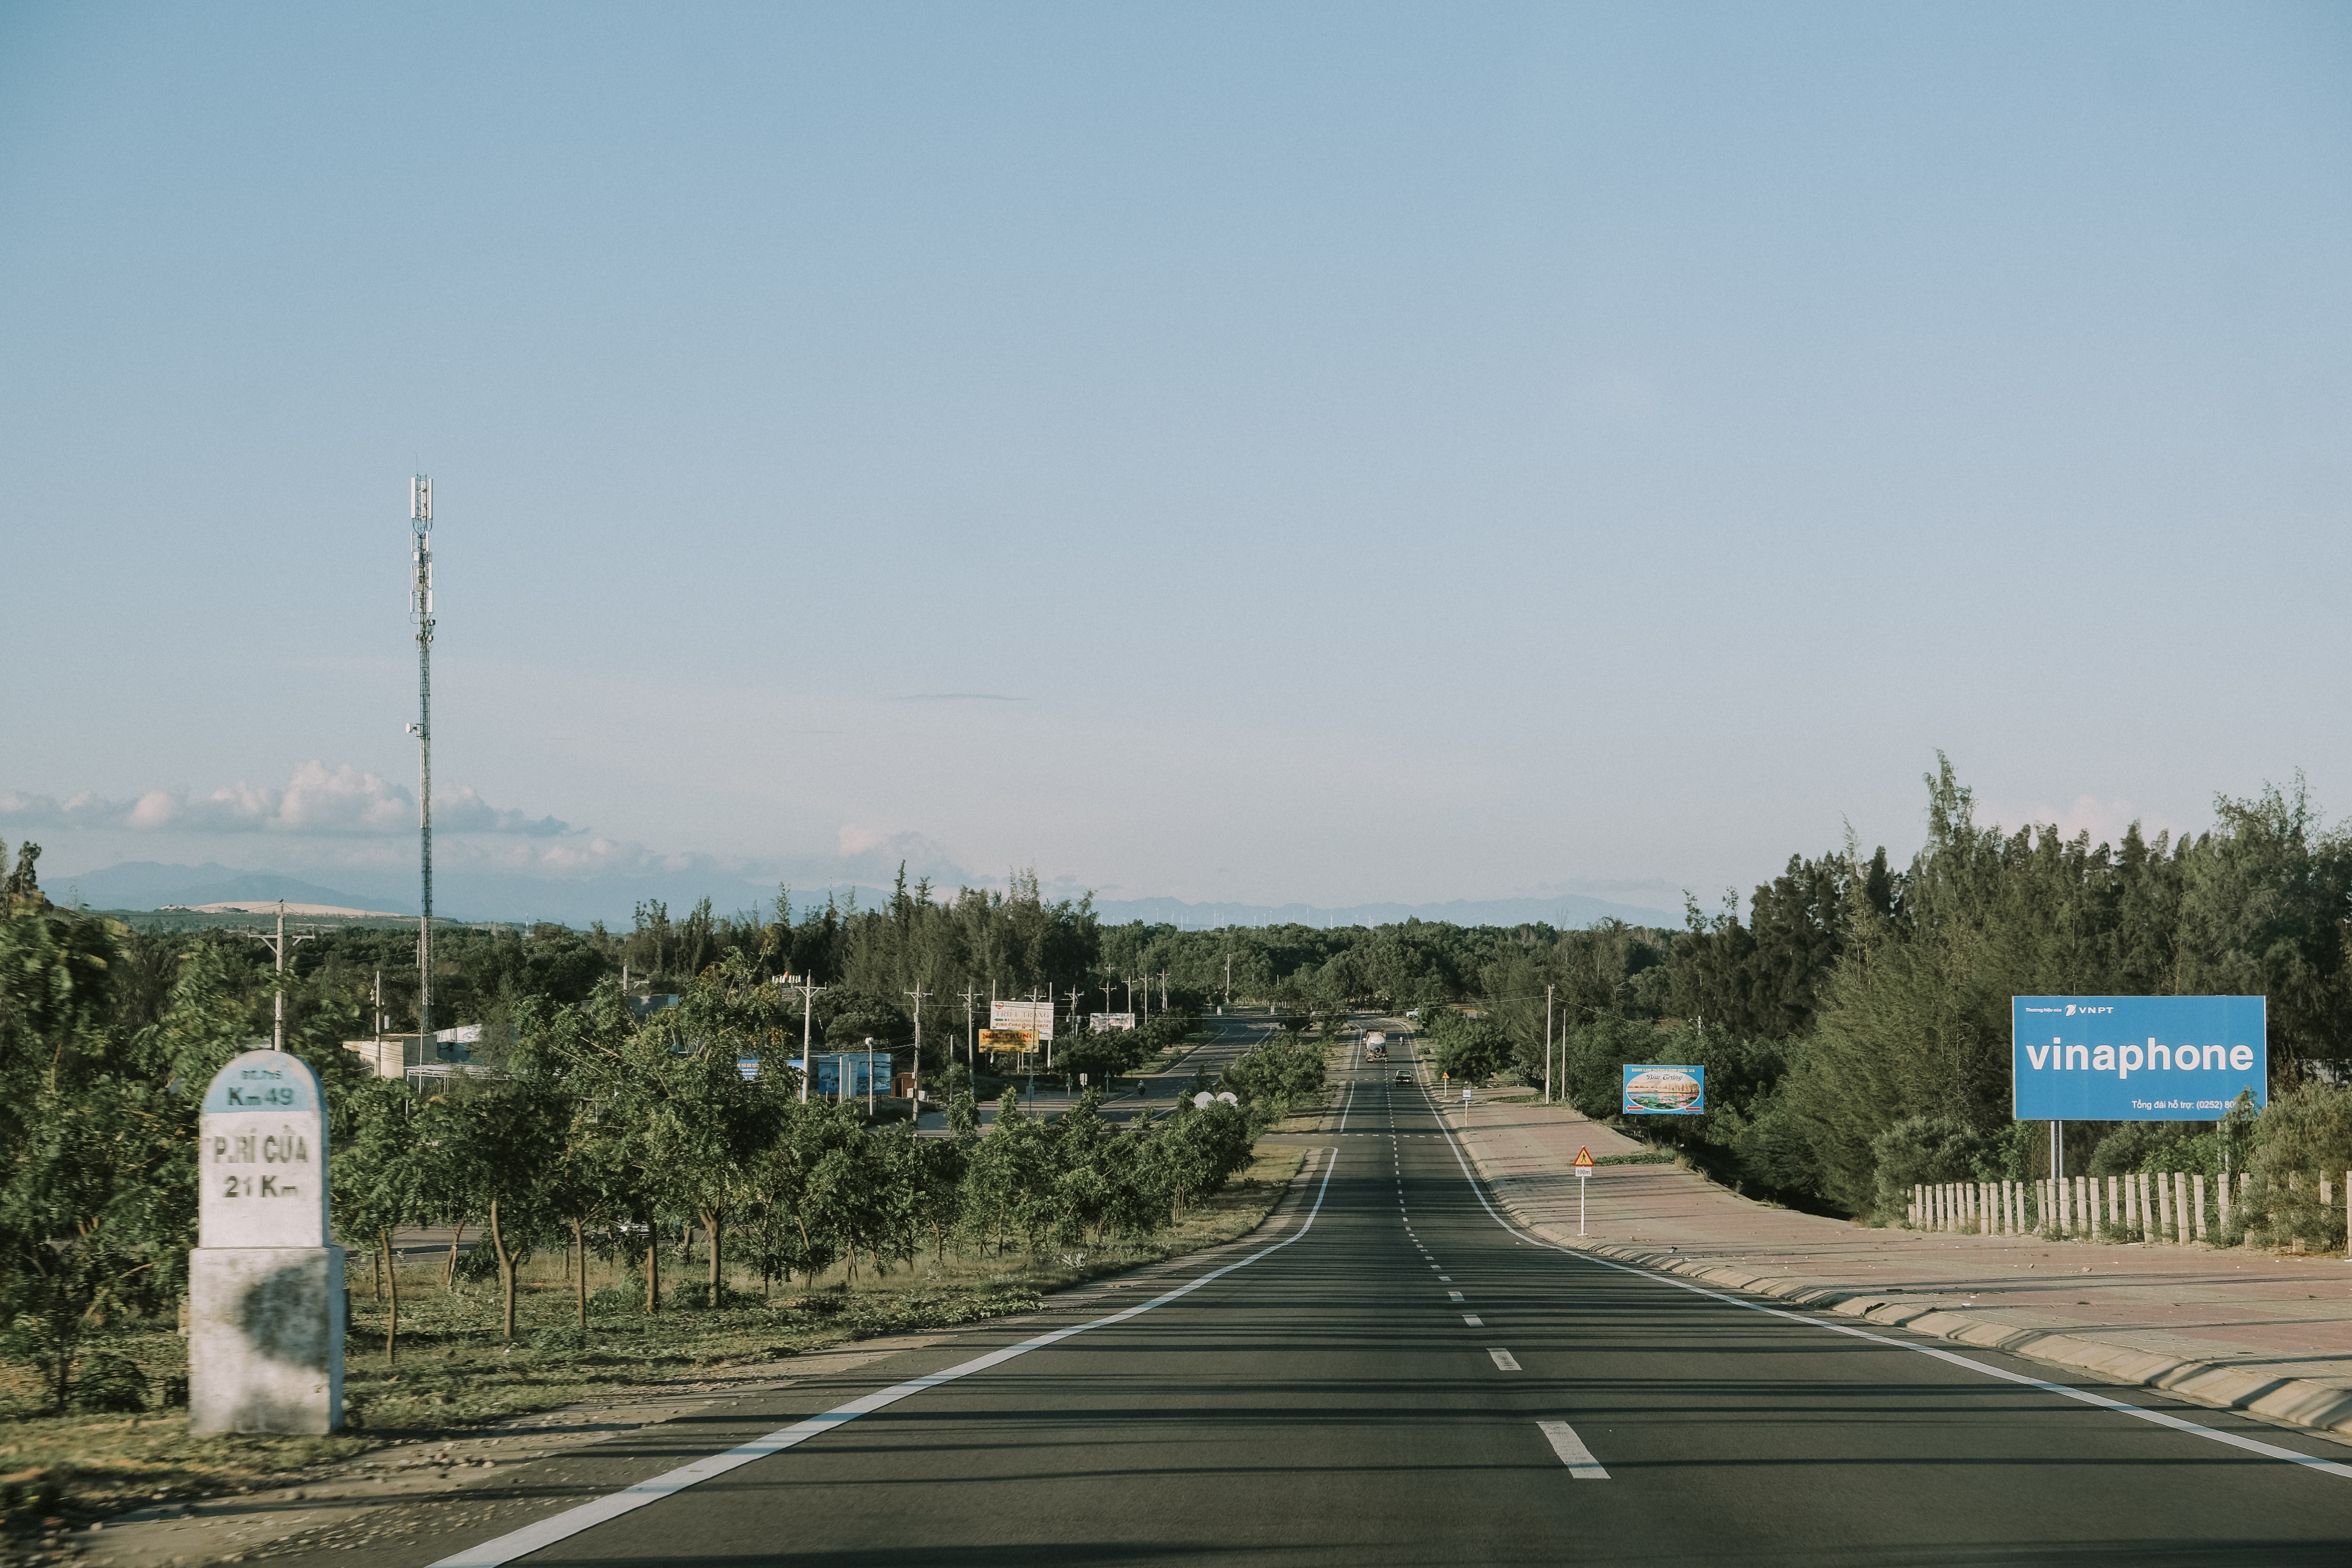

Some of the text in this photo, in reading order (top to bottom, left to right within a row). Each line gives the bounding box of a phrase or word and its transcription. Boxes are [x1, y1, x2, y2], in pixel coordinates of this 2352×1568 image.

[2026, 1037, 2254, 1079] vinaphone
[264, 1087, 294, 1105] 49
[2131, 1099, 2152, 1110] Tổng
[2154, 1100, 2166, 1109] đài
[2168, 1099, 2178, 1109] hỗ
[2180, 1101, 2194, 1110] trợ:
[2196, 1100, 2223, 1110] (0252)
[224, 1176, 252, 1197] 21
